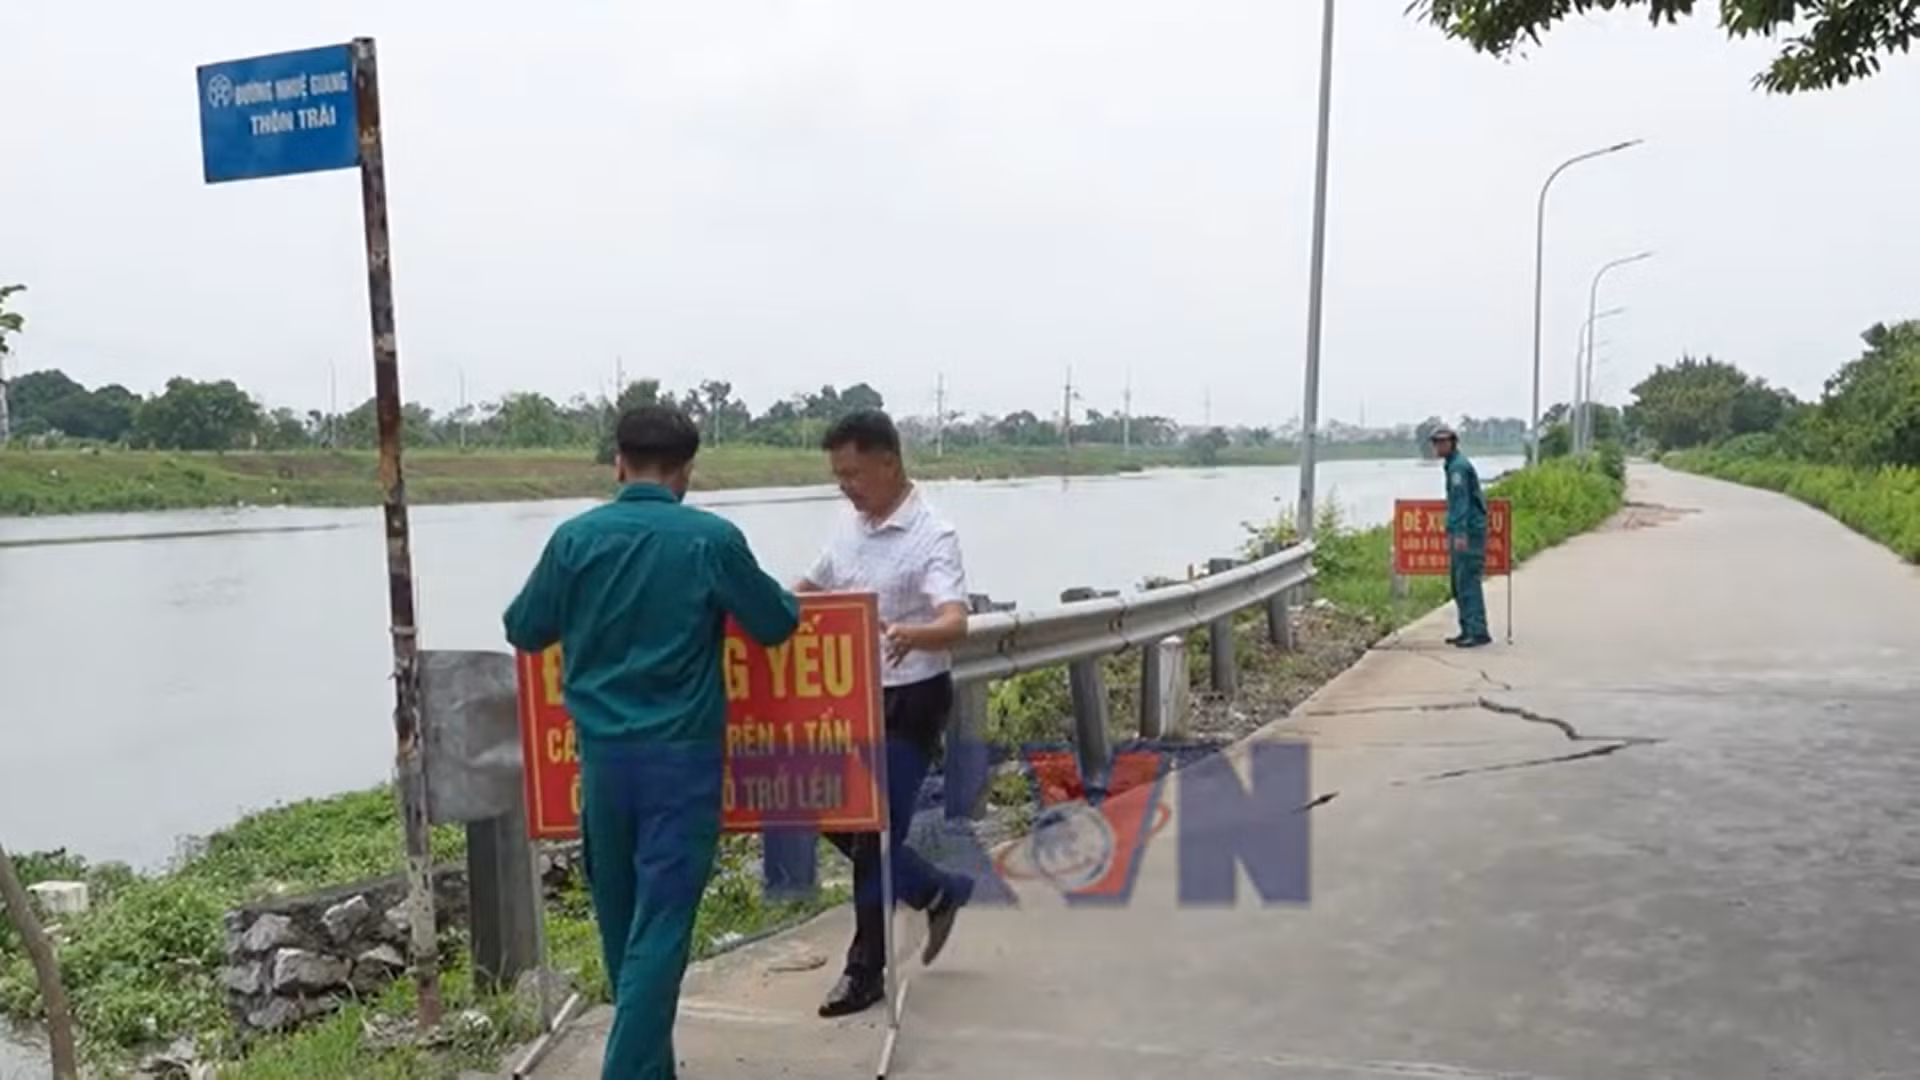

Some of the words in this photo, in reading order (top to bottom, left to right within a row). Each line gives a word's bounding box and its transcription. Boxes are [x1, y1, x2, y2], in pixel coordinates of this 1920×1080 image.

[763, 614, 853, 698] YẾU
[726, 715, 776, 757] RÊN
[784, 721, 795, 756] 1
